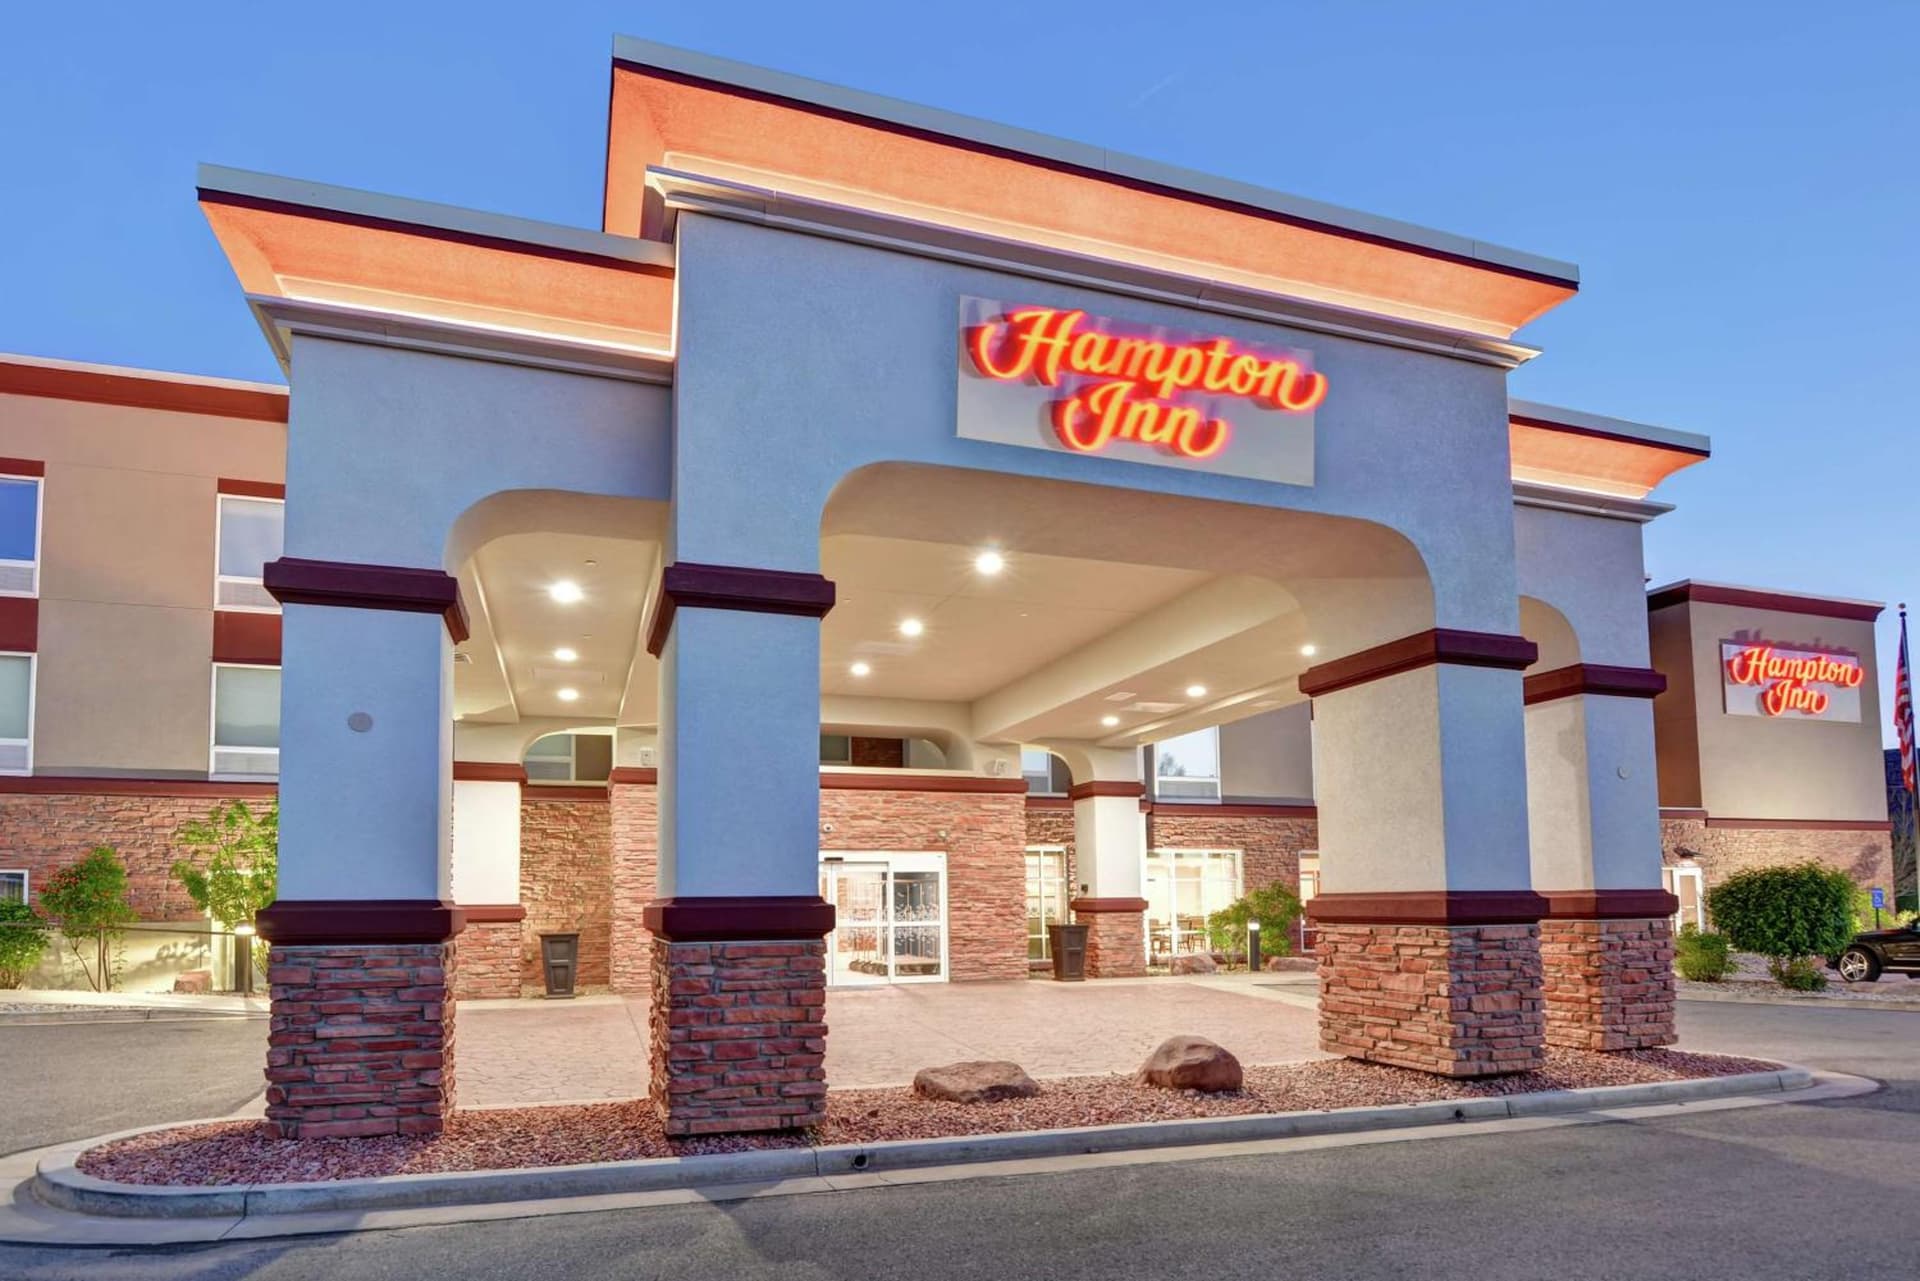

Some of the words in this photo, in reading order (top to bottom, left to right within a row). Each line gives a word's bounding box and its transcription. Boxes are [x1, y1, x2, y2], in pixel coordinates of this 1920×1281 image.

[972, 307, 1328, 411] Hampton
[1057, 380, 1229, 458] Inn
[1729, 646, 1864, 687] Hampton
[1764, 678, 1829, 716] Inn
